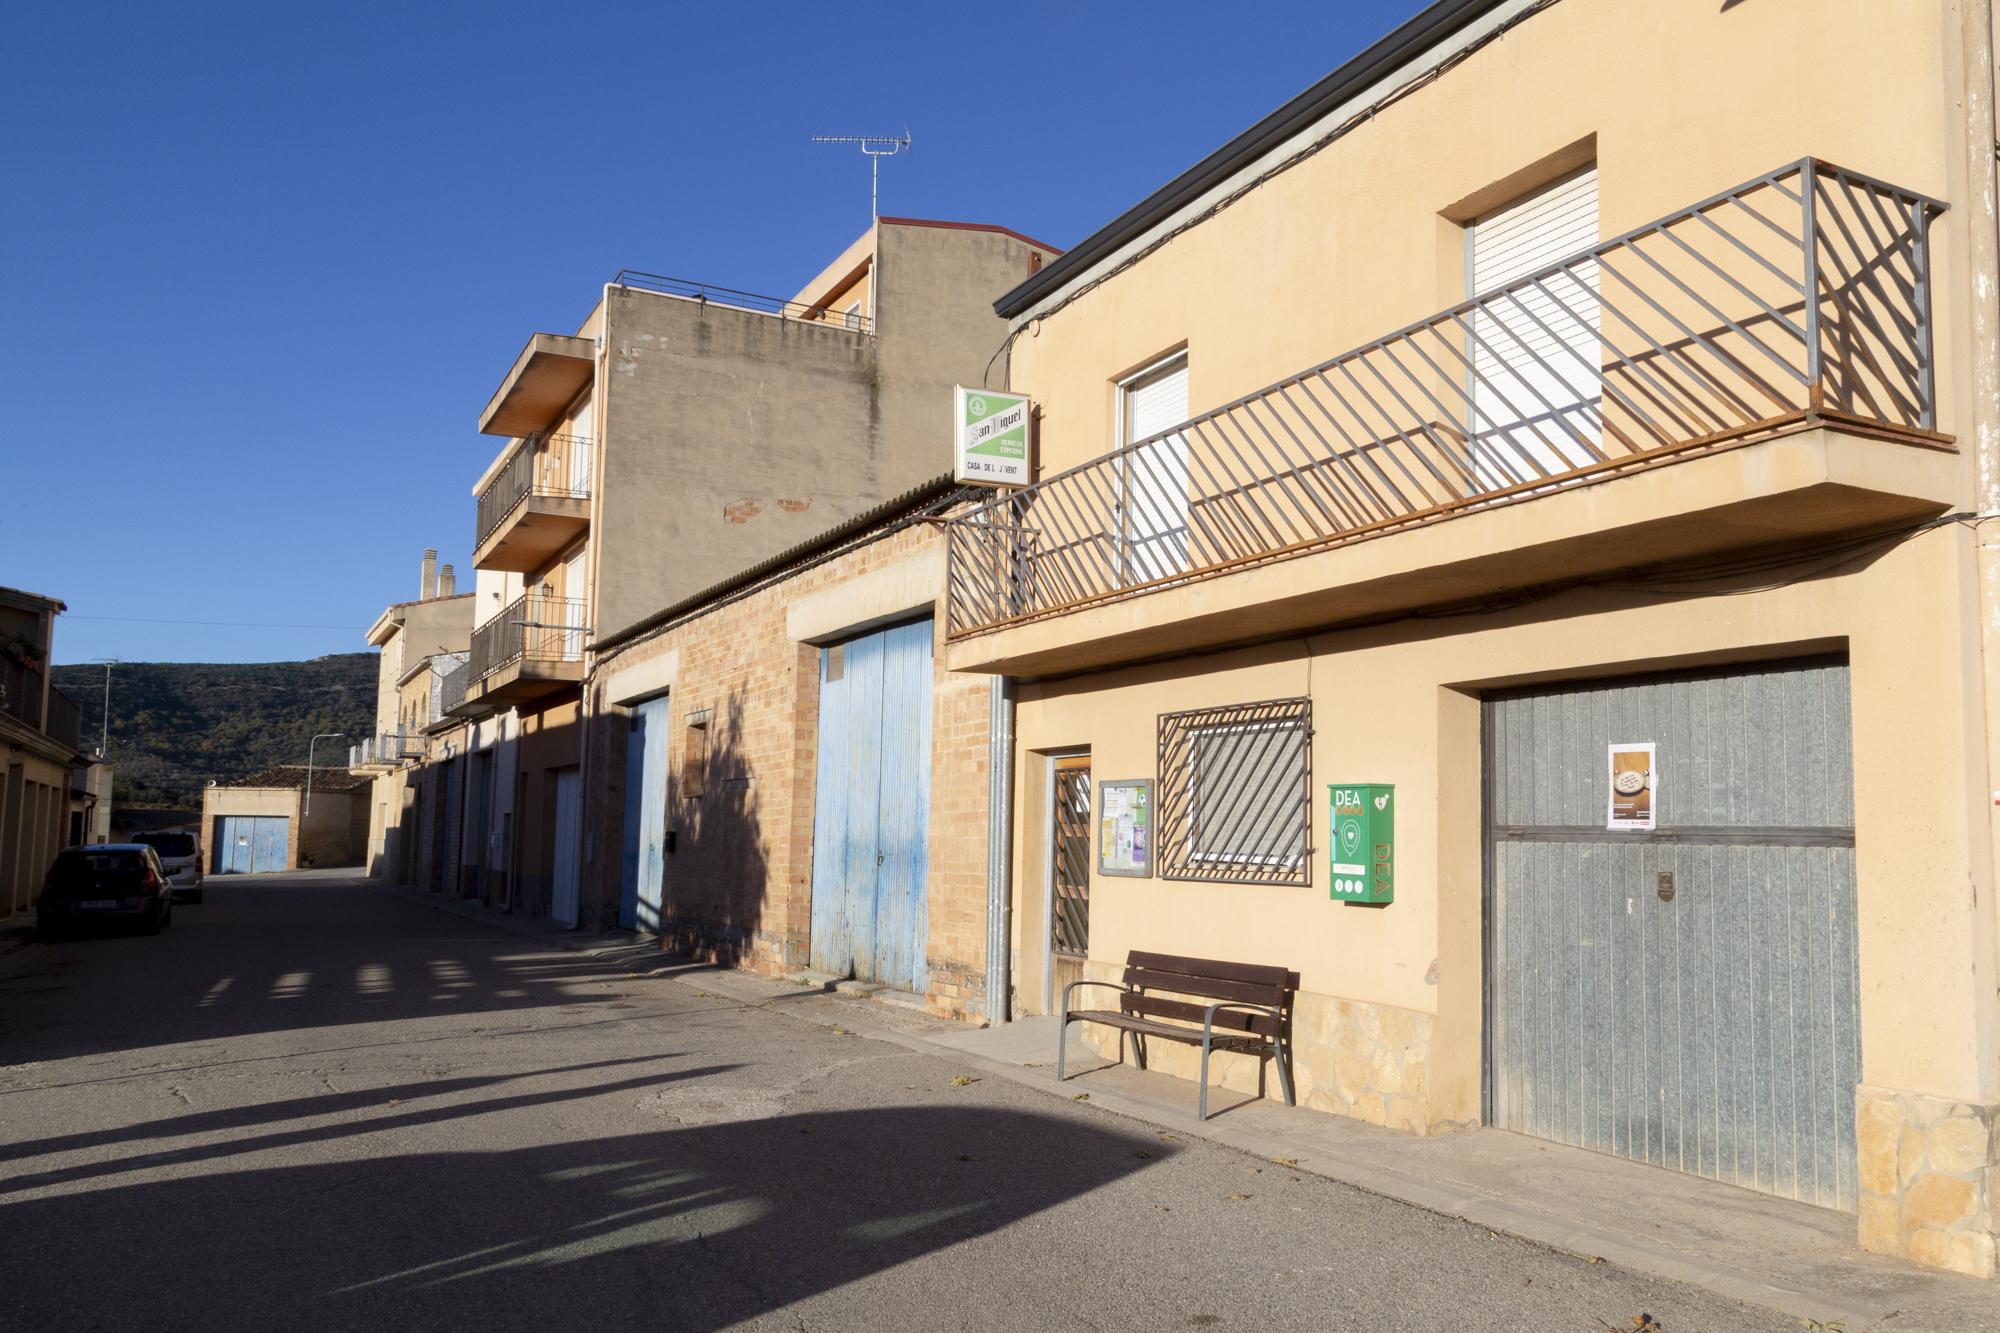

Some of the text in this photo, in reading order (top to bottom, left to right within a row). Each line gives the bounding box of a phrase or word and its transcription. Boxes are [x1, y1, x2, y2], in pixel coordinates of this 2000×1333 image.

[967, 461, 981, 470] CASA
[1335, 790, 1361, 806] DEA
[1375, 844, 1391, 895] DEA
